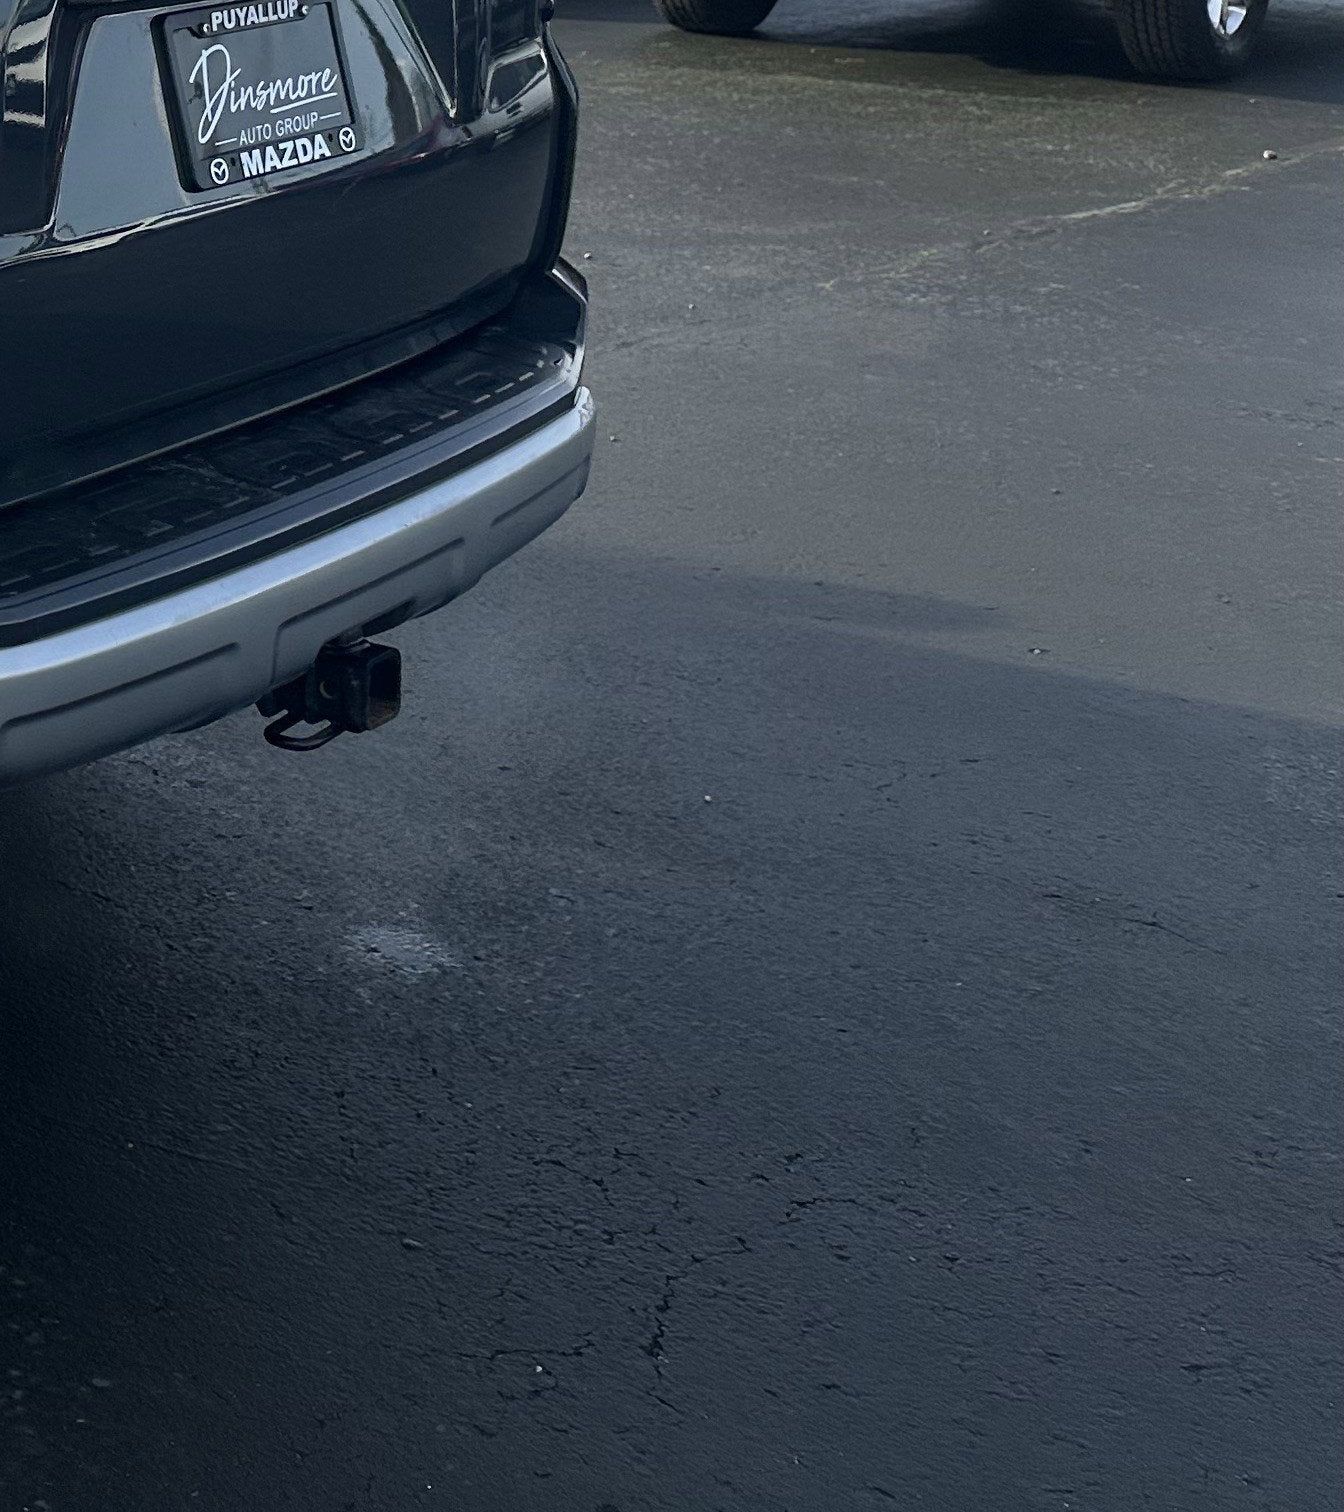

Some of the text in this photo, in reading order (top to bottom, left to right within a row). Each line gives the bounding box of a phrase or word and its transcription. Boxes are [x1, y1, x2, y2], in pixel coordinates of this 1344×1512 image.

[189, 43, 338, 144] Dinsmore
[239, 111, 319, 147] AUTO GROUP
[239, 133, 332, 178] MAZDA
